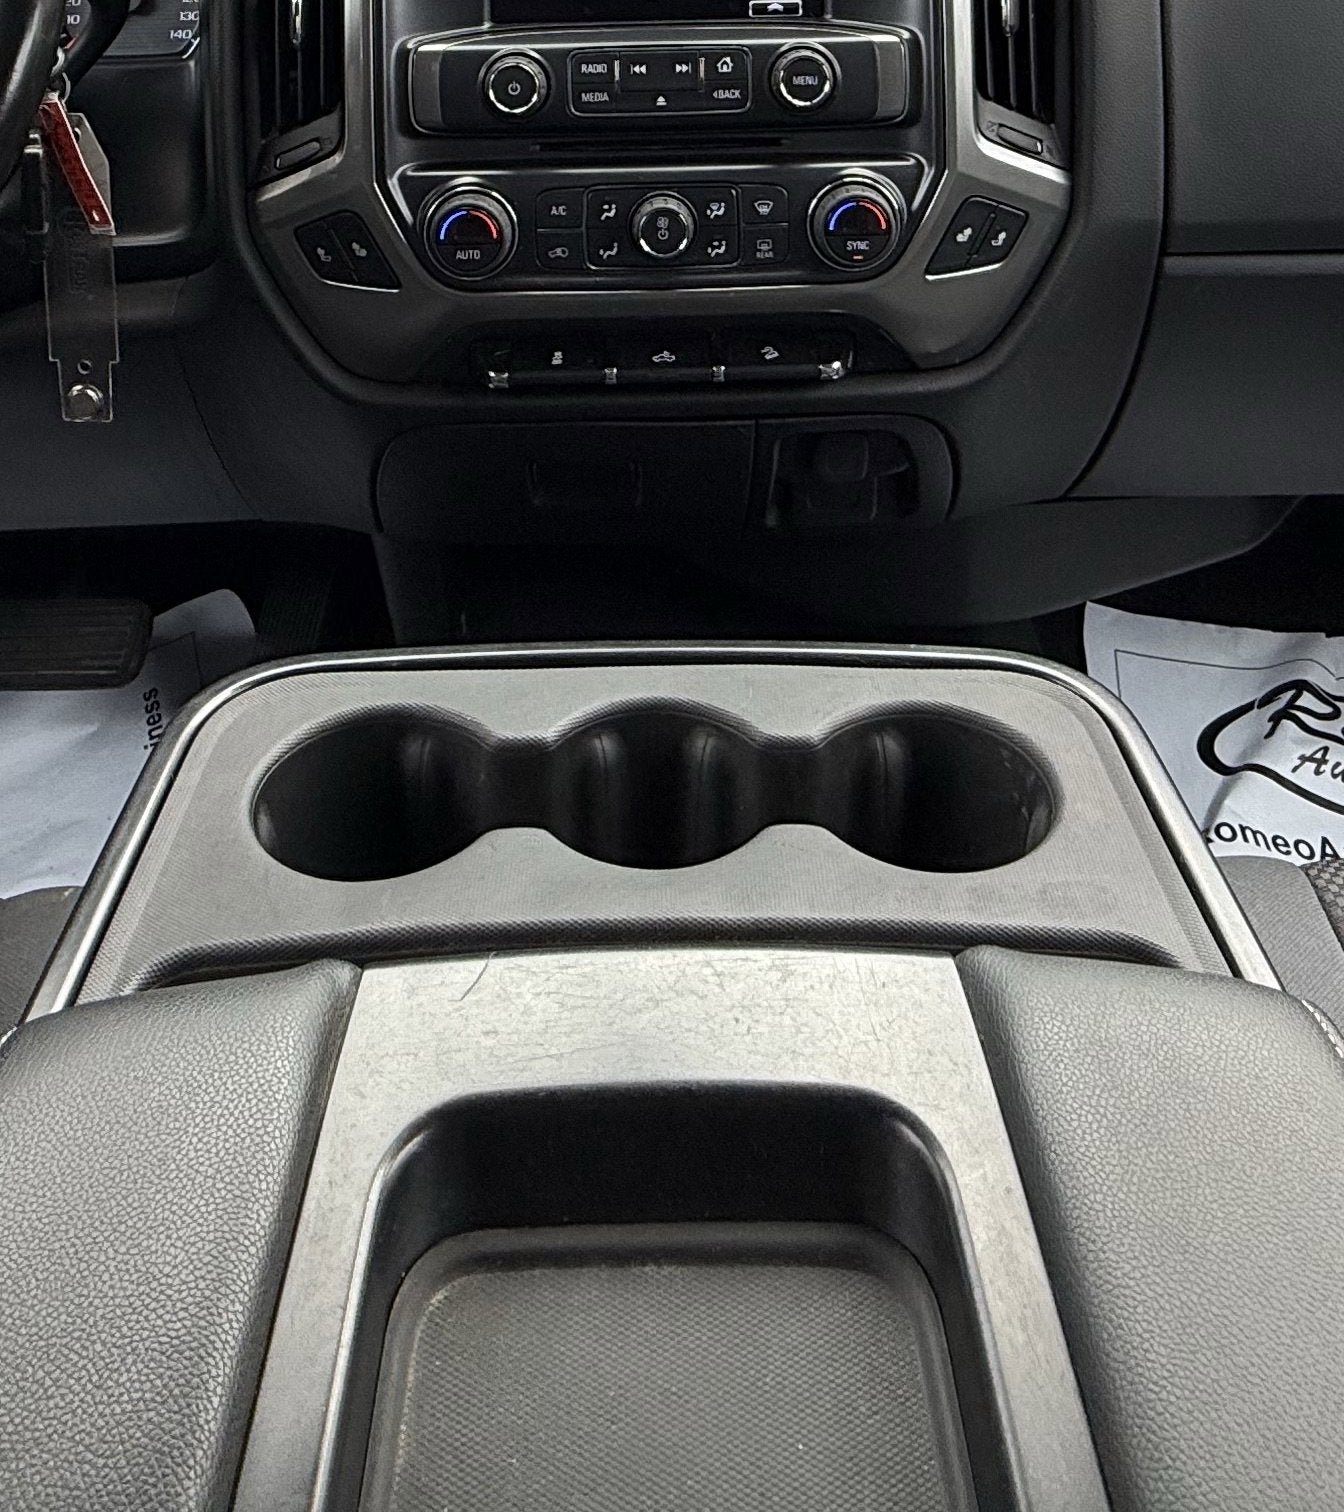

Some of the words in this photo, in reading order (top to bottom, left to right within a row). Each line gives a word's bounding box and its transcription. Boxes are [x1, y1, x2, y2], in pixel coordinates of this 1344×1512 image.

[170, 29, 193, 40] 140
[581, 63, 607, 74] RADIO
[792, 74, 818, 86] MENU
[581, 92, 609, 103] MEDIA
[717, 89, 742, 100] BACK
[550, 203, 567, 217] A/C
[846, 240, 870, 252] SYNC
[455, 249, 481, 261] AUTO
